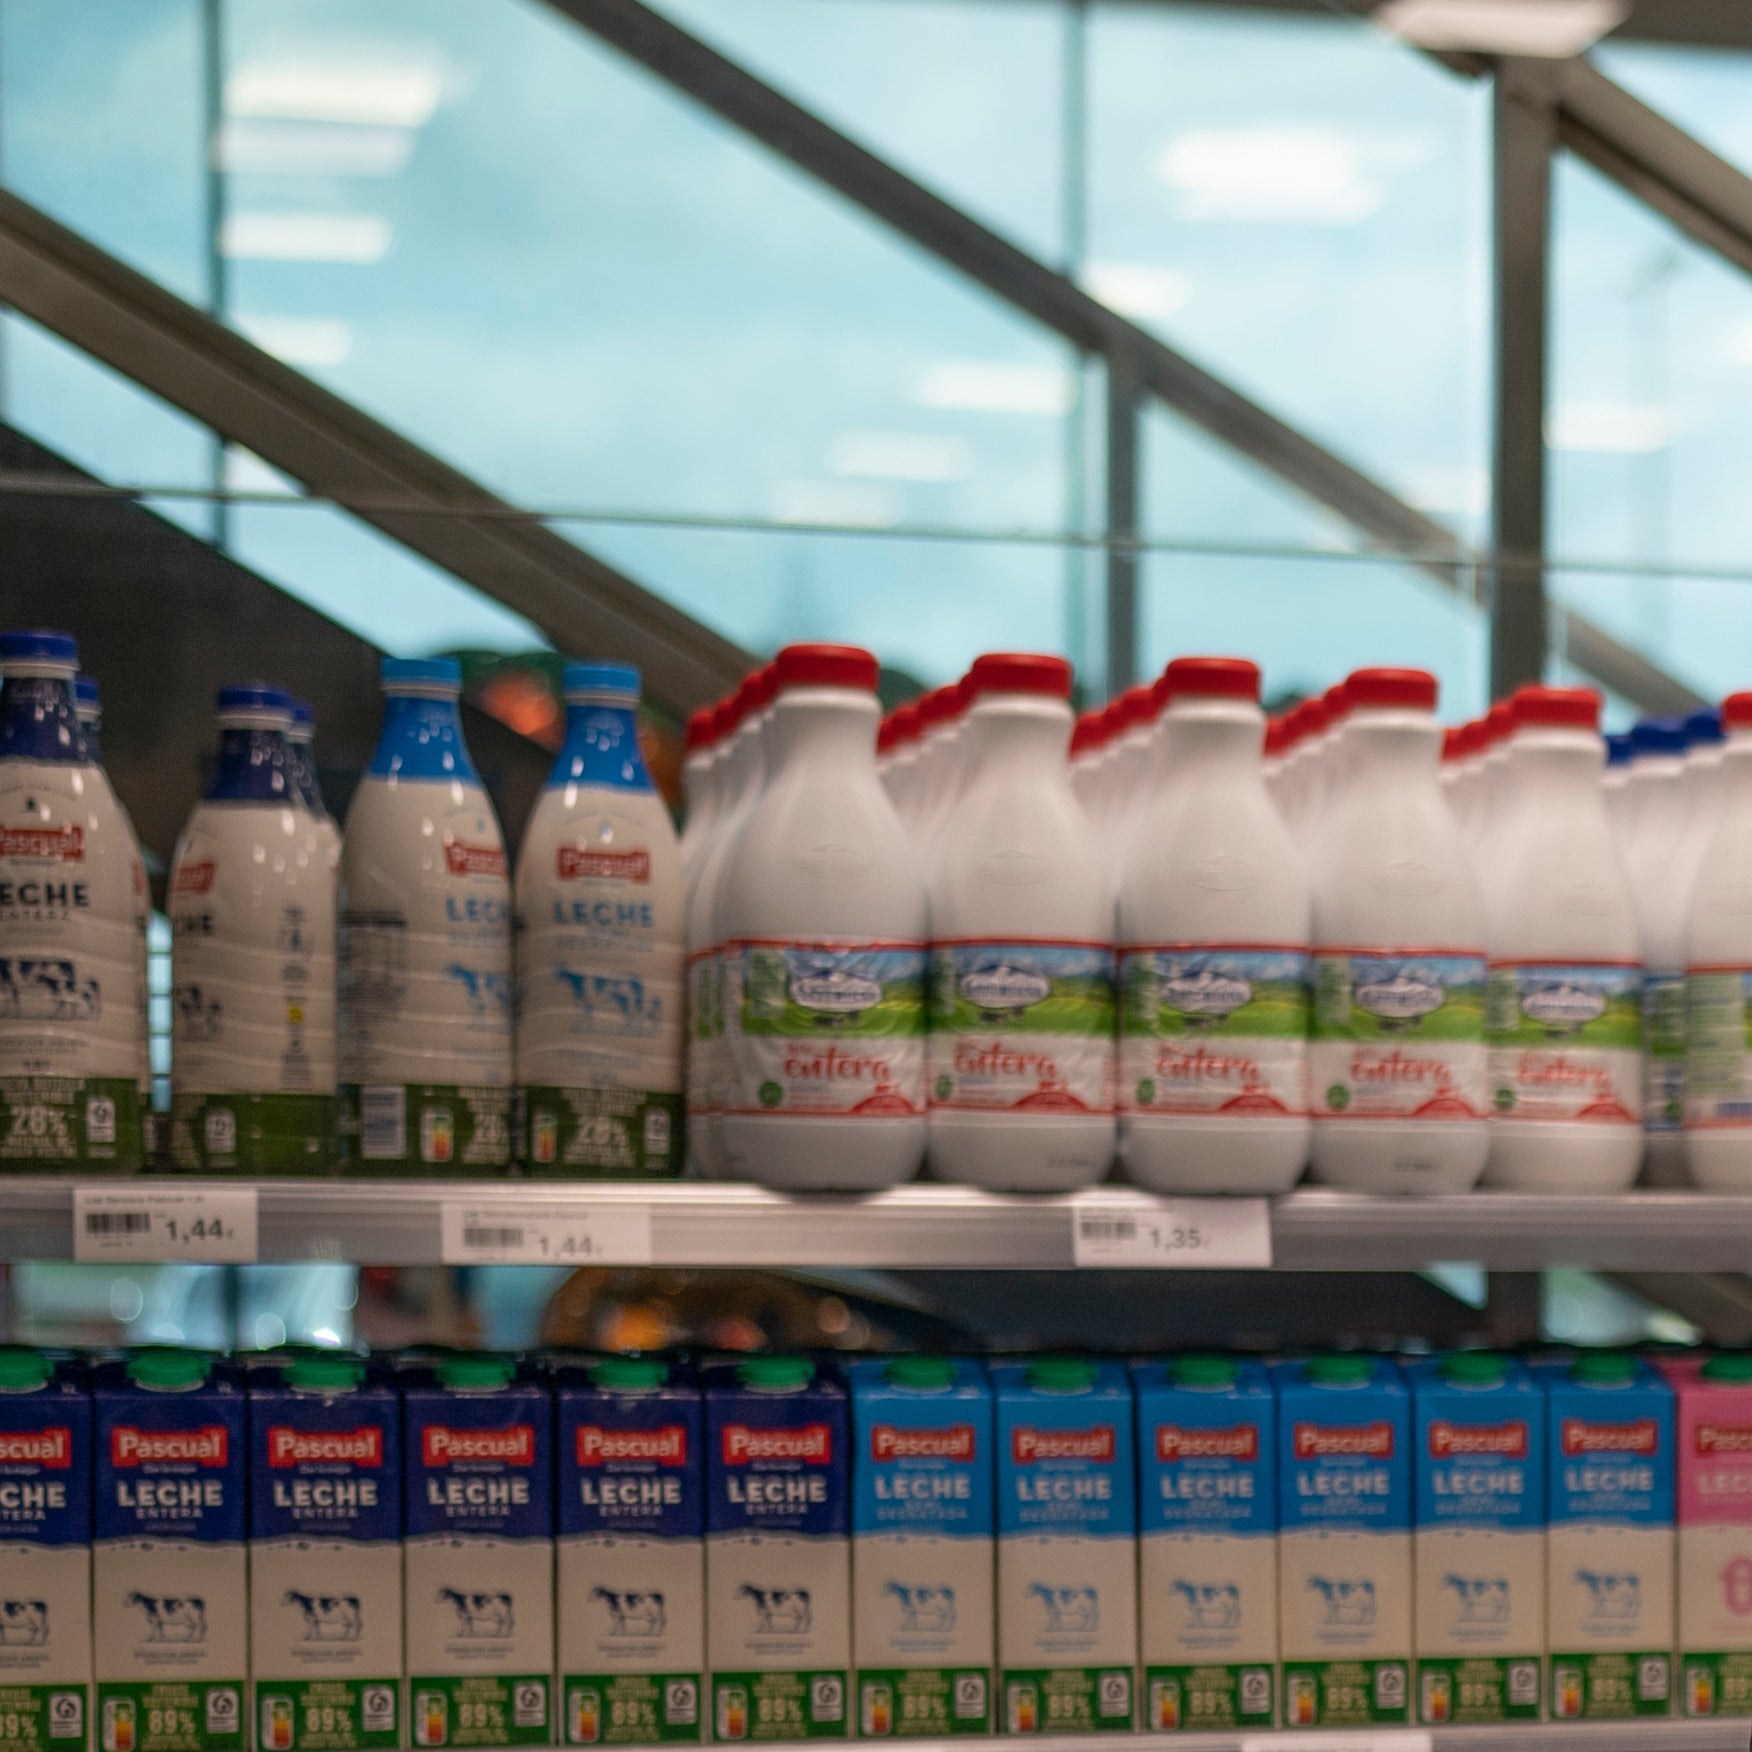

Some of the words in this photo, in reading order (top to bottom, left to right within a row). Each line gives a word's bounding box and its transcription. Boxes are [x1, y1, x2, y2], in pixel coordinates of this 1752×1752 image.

[0, 830, 83, 858] ascual
[0, 884, 90, 907] ECHE
[446, 898, 510, 924] LEC
[553, 901, 655, 927] LECHE
[0, 1432, 64, 1459] scual
[118, 1429, 221, 1459] Pascual
[275, 1431, 377, 1459] Pascual
[429, 1430, 529, 1458] Pascual
[582, 1430, 681, 1458] Pascual
[728, 1429, 826, 1457] Pascual
[877, 1430, 971, 1456] Pascual
[1018, 1432, 1112, 1458] Pascual
[1162, 1429, 1255, 1456] Pascual
[1300, 1426, 1390, 1454] Pascual
[1435, 1425, 1524, 1453] Pascual
[1566, 1423, 1655, 1450] Pascual
[427, 1478, 530, 1505] LECHE
[580, 1477, 683, 1504] LECHE
[726, 1475, 828, 1503] LECHE
[874, 1471, 971, 1499] LECHE
[1015, 1473, 1112, 1500] LECHE
[1160, 1471, 1255, 1499] LECHE
[1297, 1469, 1390, 1497] LECHE
[1431, 1469, 1525, 1496] LECHE
[1564, 1466, 1654, 1492] LECHE
[0, 1481, 66, 1508] CHE
[117, 1479, 223, 1507] LECHE
[273, 1480, 378, 1507] LECHE
[0, 1509, 47, 1522] TERA
[148, 1708, 196, 1735] 89%
[305, 1707, 352, 1733] 89%
